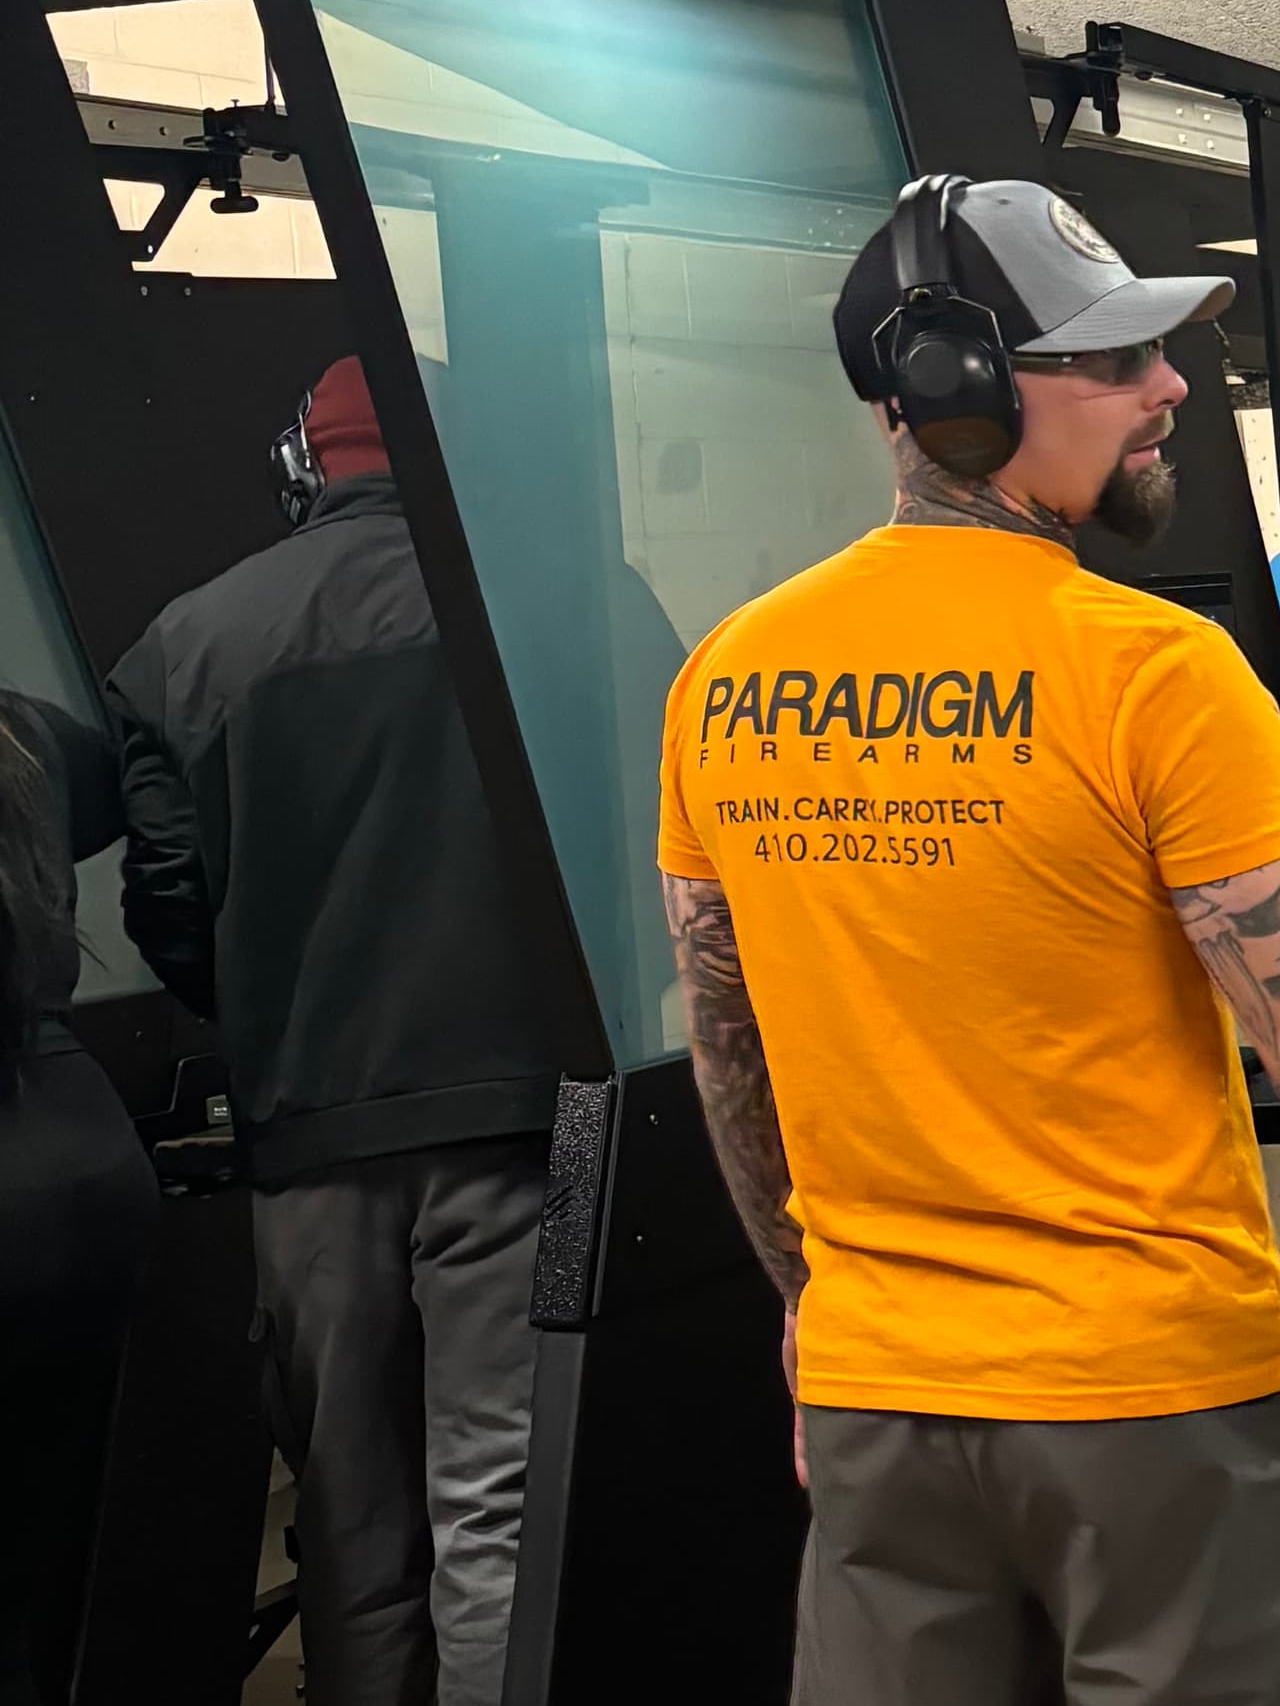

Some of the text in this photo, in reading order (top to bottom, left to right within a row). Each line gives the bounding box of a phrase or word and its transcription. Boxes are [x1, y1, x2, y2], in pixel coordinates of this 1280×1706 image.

[701, 670, 1035, 744] PARADIGM
[699, 740, 1033, 769] FIREARMS
[754, 832, 955, 866] 410.202.5591
